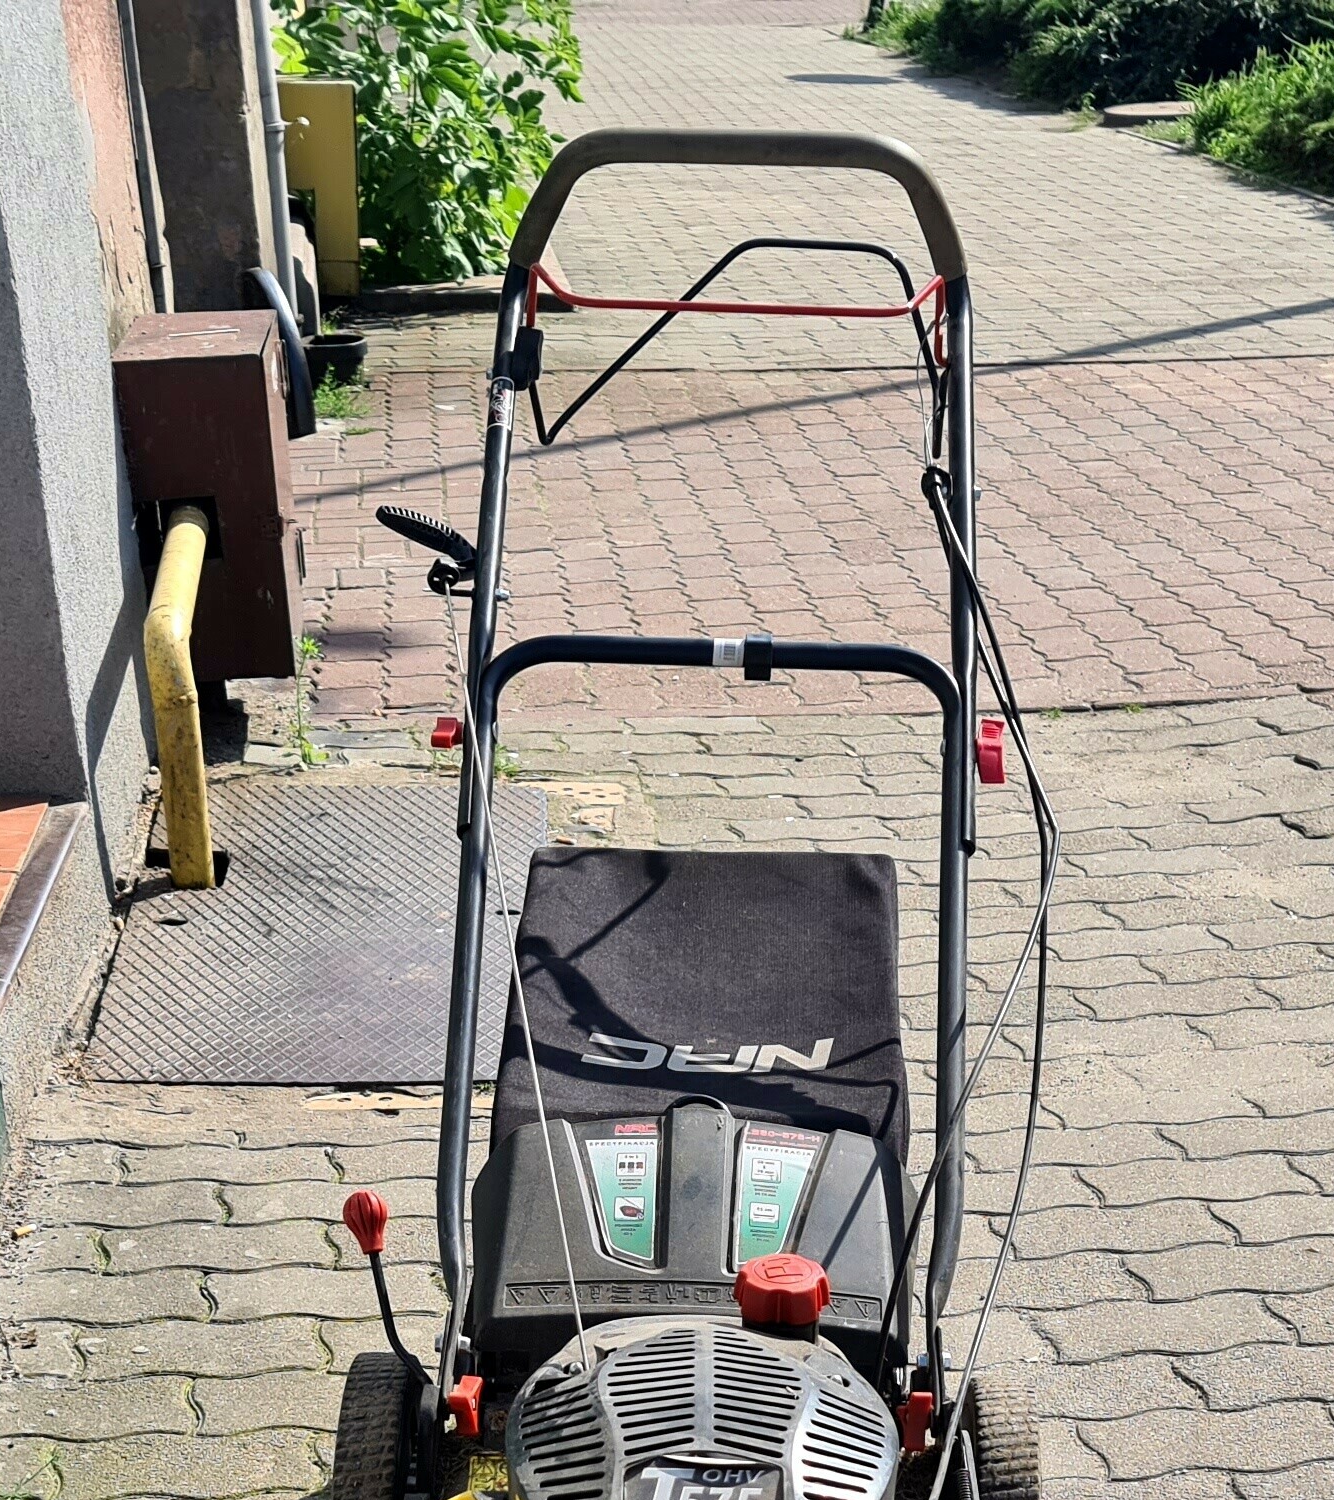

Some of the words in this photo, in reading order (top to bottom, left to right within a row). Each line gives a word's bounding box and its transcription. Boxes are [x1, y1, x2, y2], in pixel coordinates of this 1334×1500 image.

[580, 1032, 836, 1073] NAC
[615, 1124, 657, 1134] NAC
[702, 1469, 765, 1484] OHV
